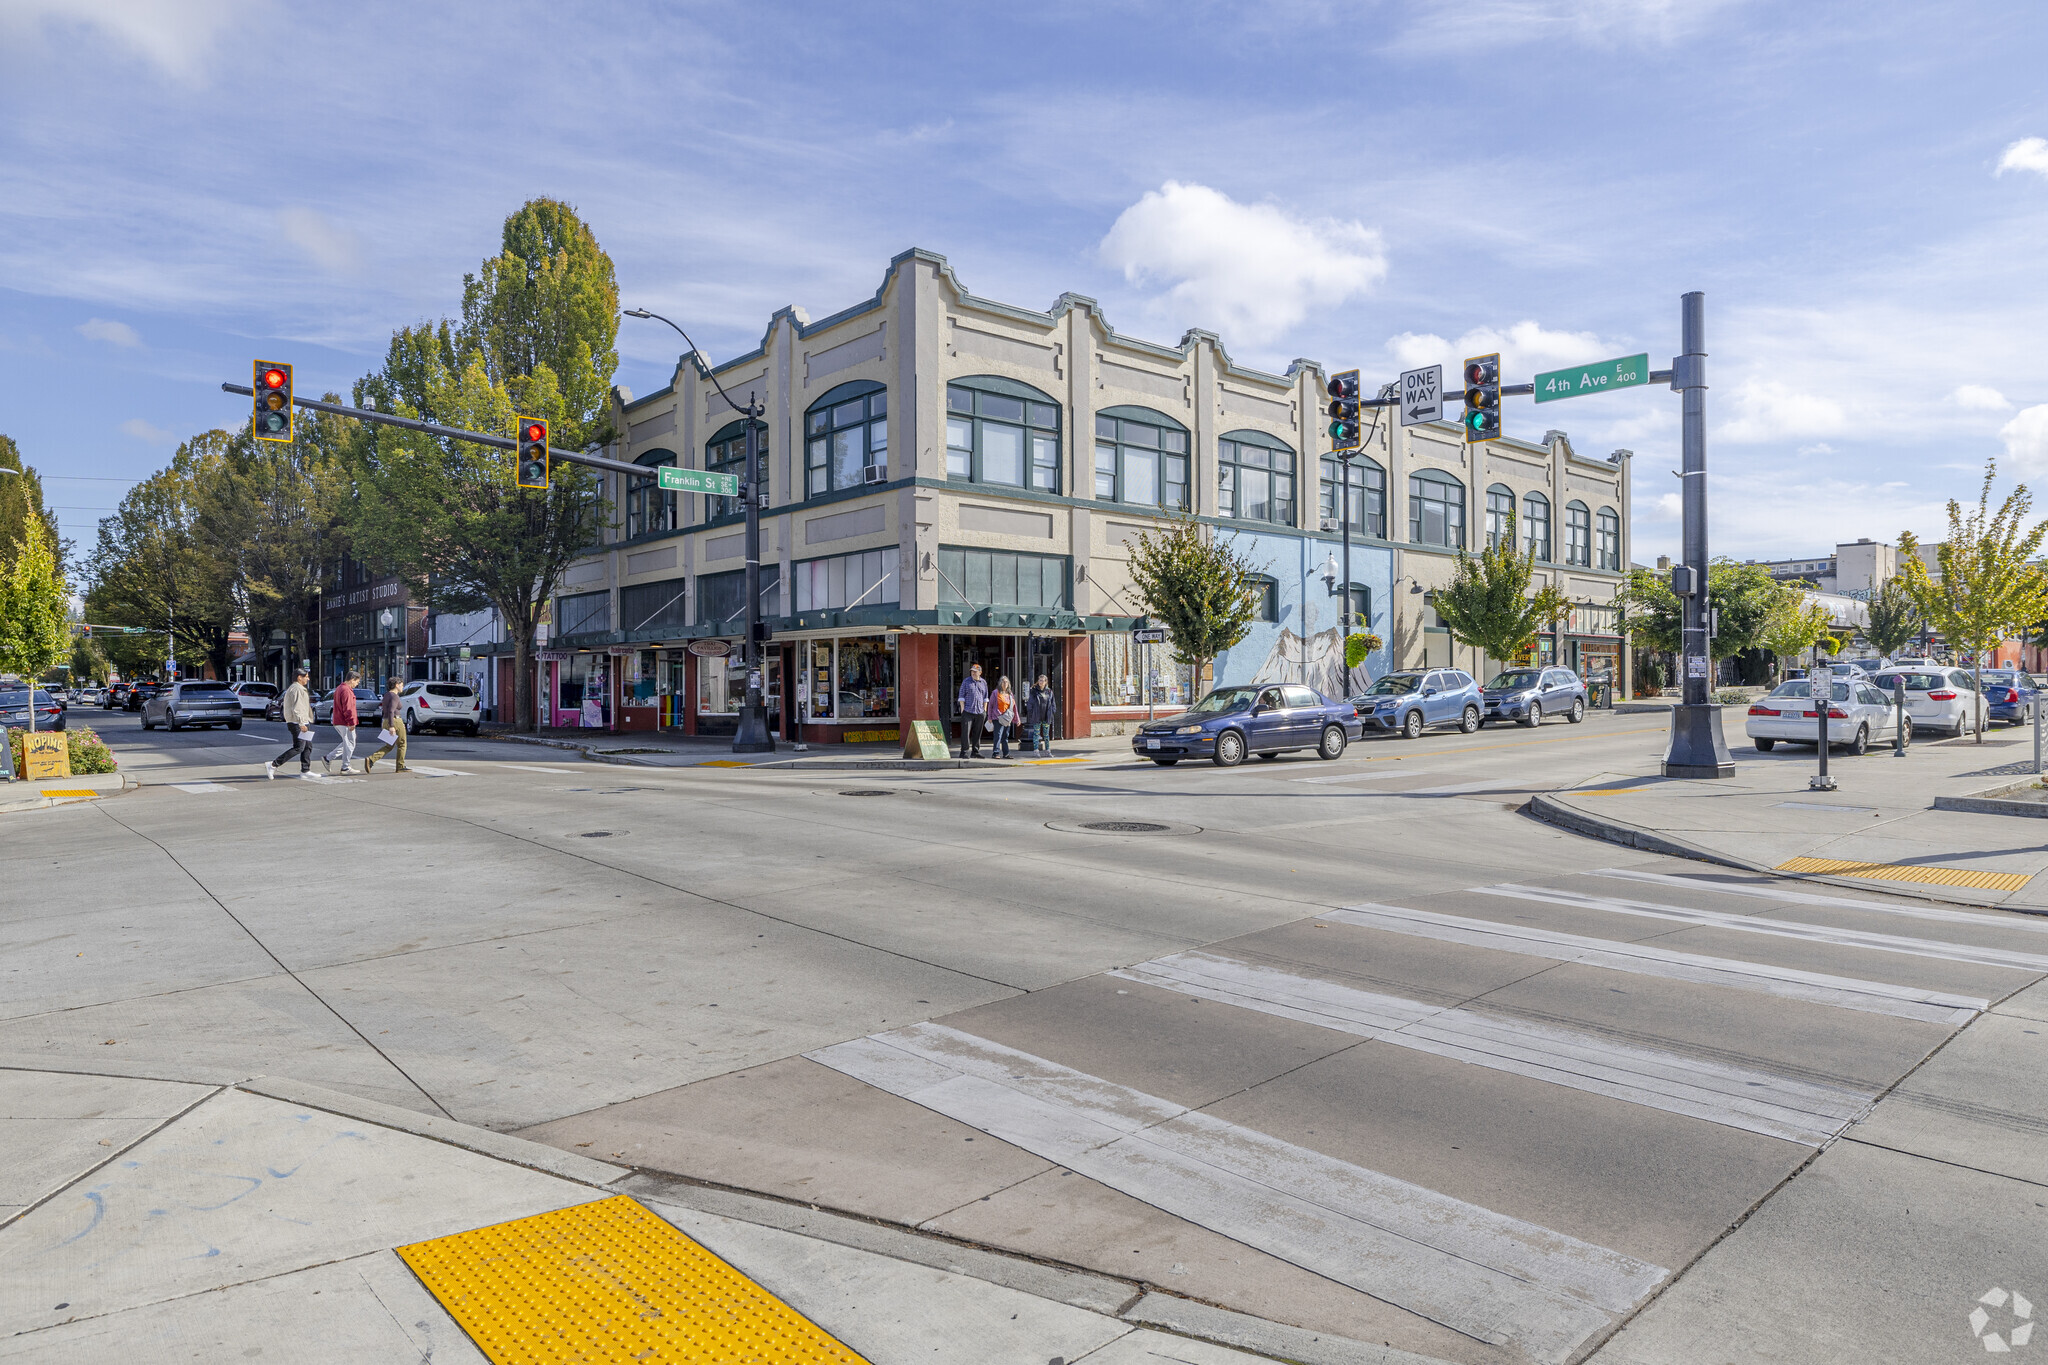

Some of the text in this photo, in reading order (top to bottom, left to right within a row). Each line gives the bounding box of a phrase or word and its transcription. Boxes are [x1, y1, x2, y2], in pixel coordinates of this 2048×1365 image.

[1616, 363, 1623, 373] E
[1616, 371, 1637, 383] 400
[1407, 370, 1435, 389] ONE
[1545, 372, 1608, 393] 4th Ave
[1405, 385, 1437, 405] WAY
[664, 471, 716, 489] Franklin St
[348, 589, 369, 605] ARTIST
[372, 583, 398, 600] STUDIOS
[543, 652, 568, 660] TATTOO
